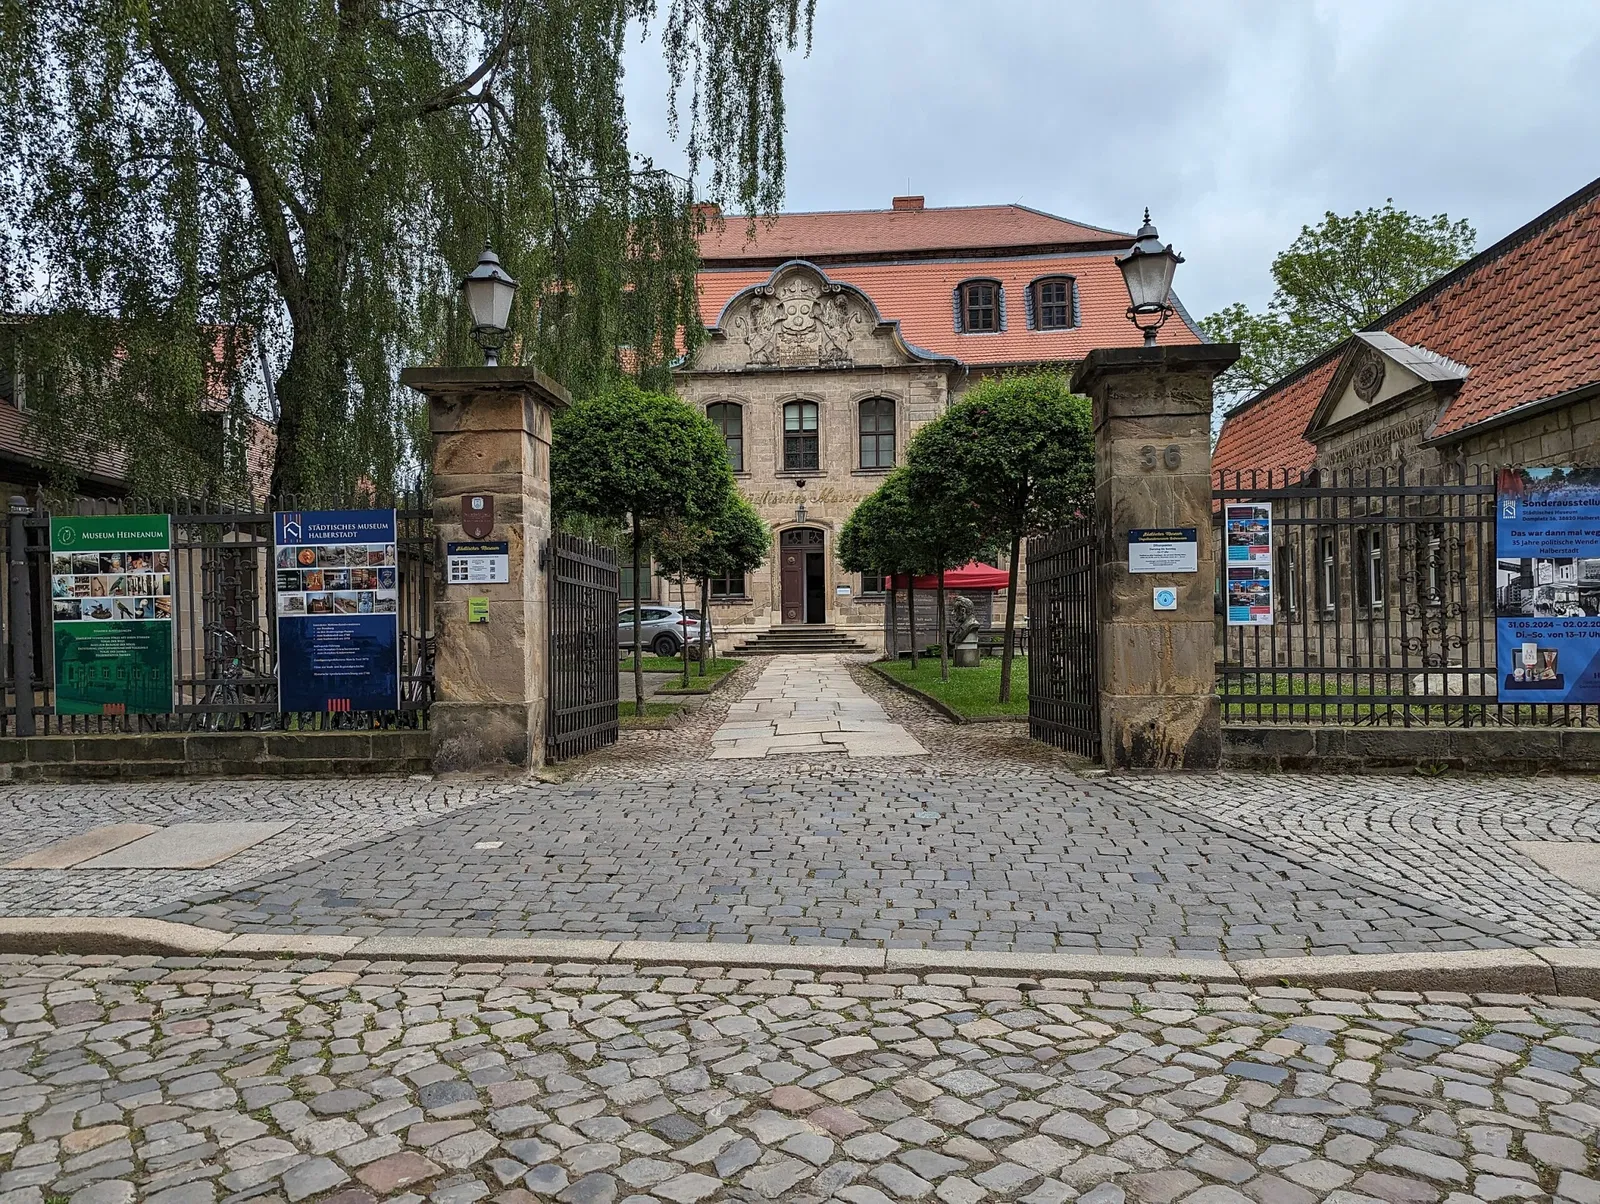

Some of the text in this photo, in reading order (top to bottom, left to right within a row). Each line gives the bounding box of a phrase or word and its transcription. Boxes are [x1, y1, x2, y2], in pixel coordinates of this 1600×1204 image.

[1140, 444, 1181, 469] 36
[308, 523, 356, 532] STÄDTISCHES
[308, 531, 358, 539] HALBERSTADT
[1545, 529, 1566, 537] dann
[1541, 539, 1574, 547] politische
[1508, 621, 1554, 629] 31.05.2024
